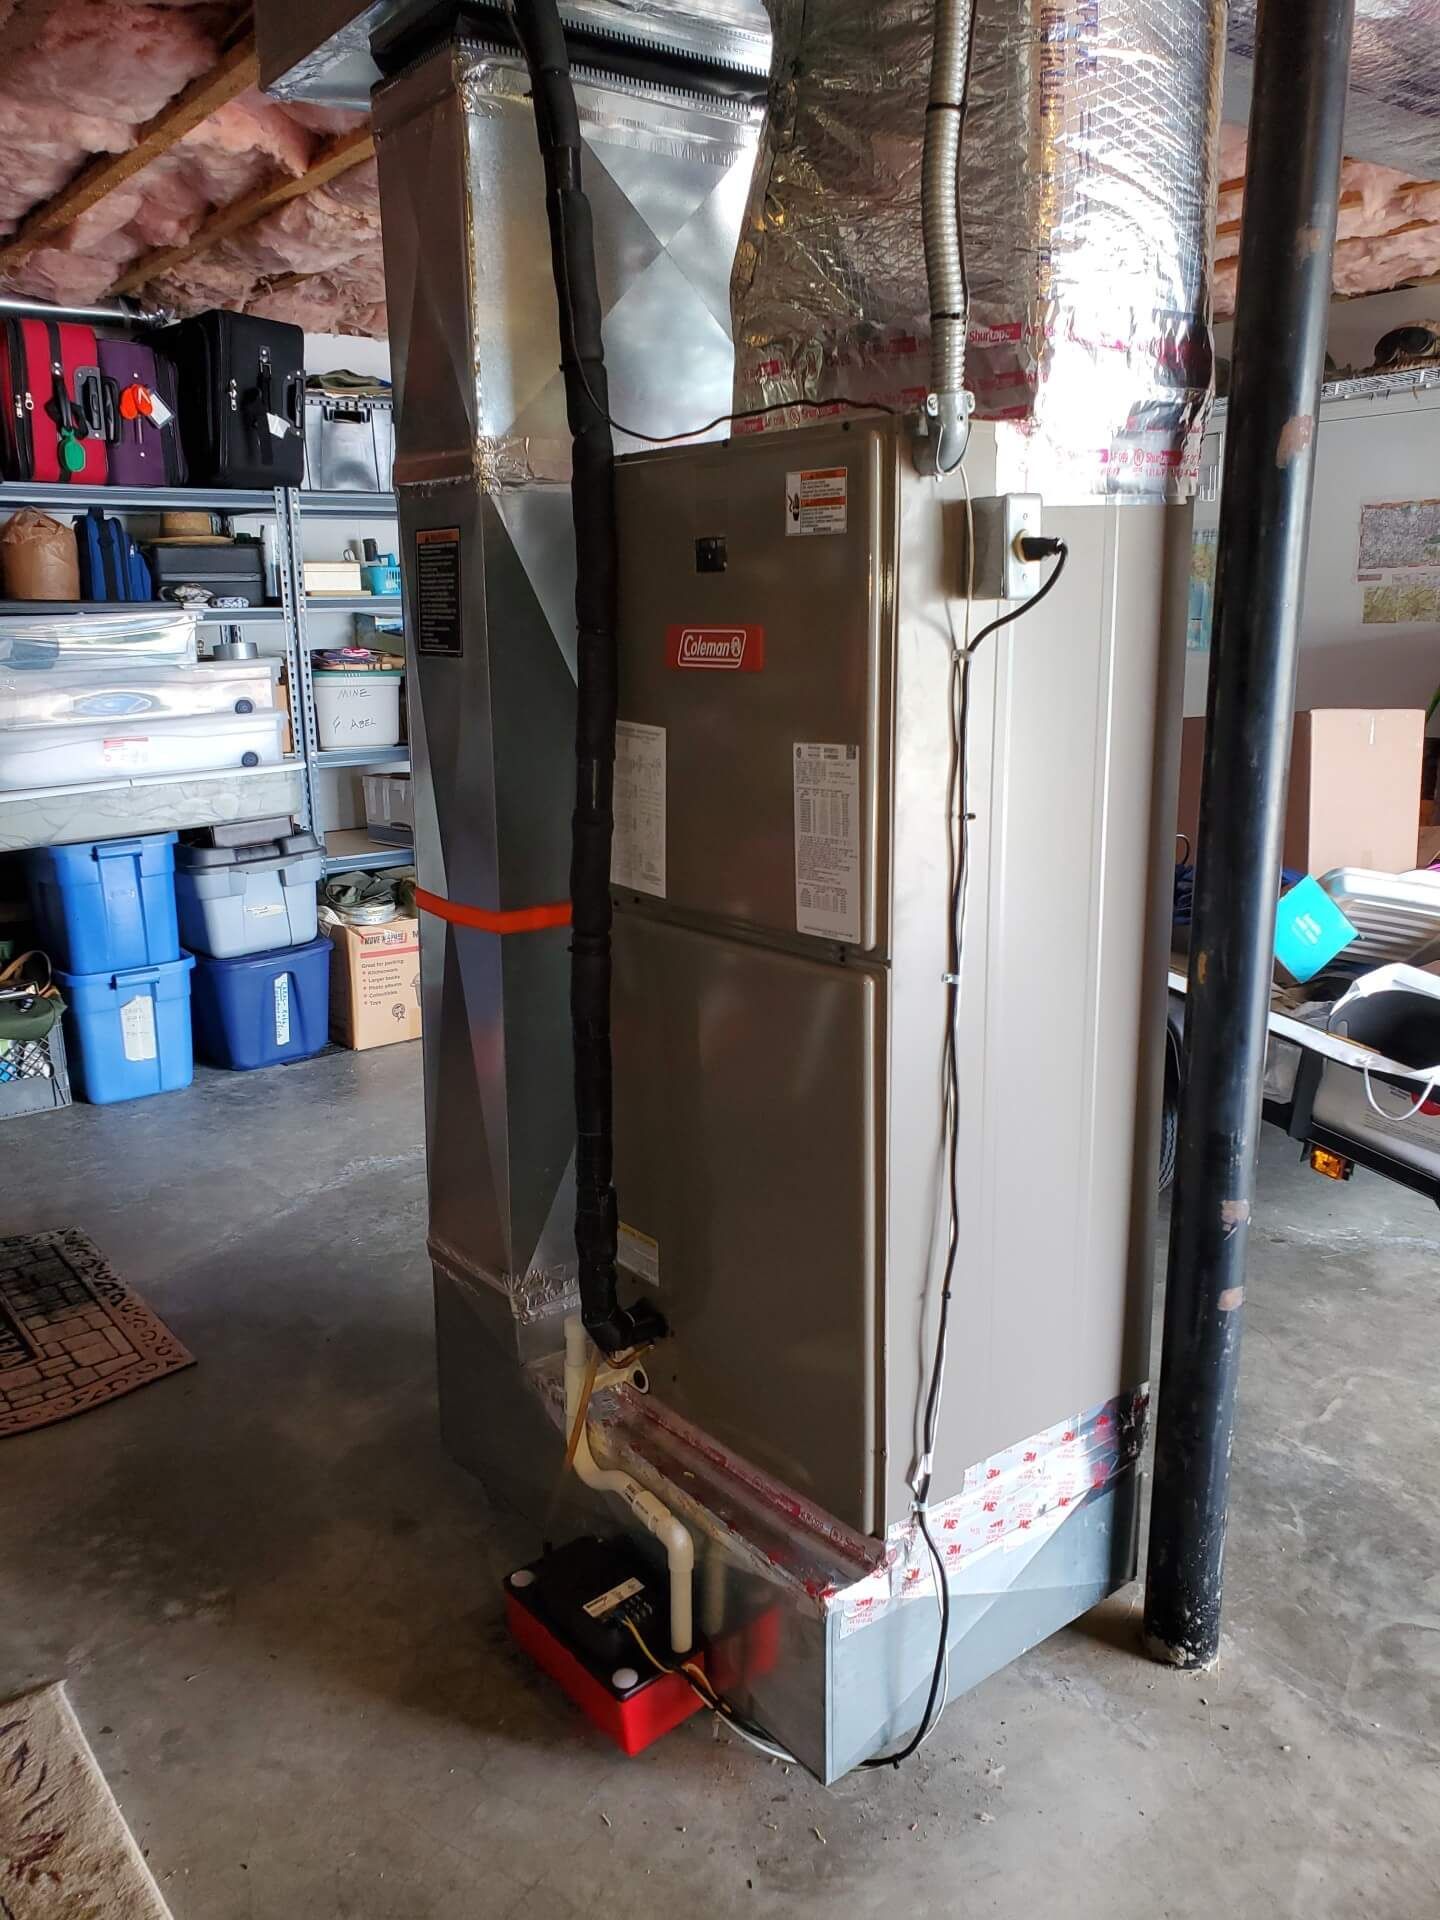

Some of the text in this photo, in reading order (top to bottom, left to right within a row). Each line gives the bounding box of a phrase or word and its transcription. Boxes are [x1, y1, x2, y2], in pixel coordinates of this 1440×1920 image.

[684, 635, 730, 657] Coleman
[338, 688, 371, 698] MINE
[1062, 1431, 1076, 1442] 3M
[1023, 1451, 1037, 1462] 3M
[985, 1469, 1001, 1480] 3M
[983, 1501, 998, 1512] 3M
[944, 1519, 958, 1530] 3M
[946, 1543, 961, 1555] 3M
